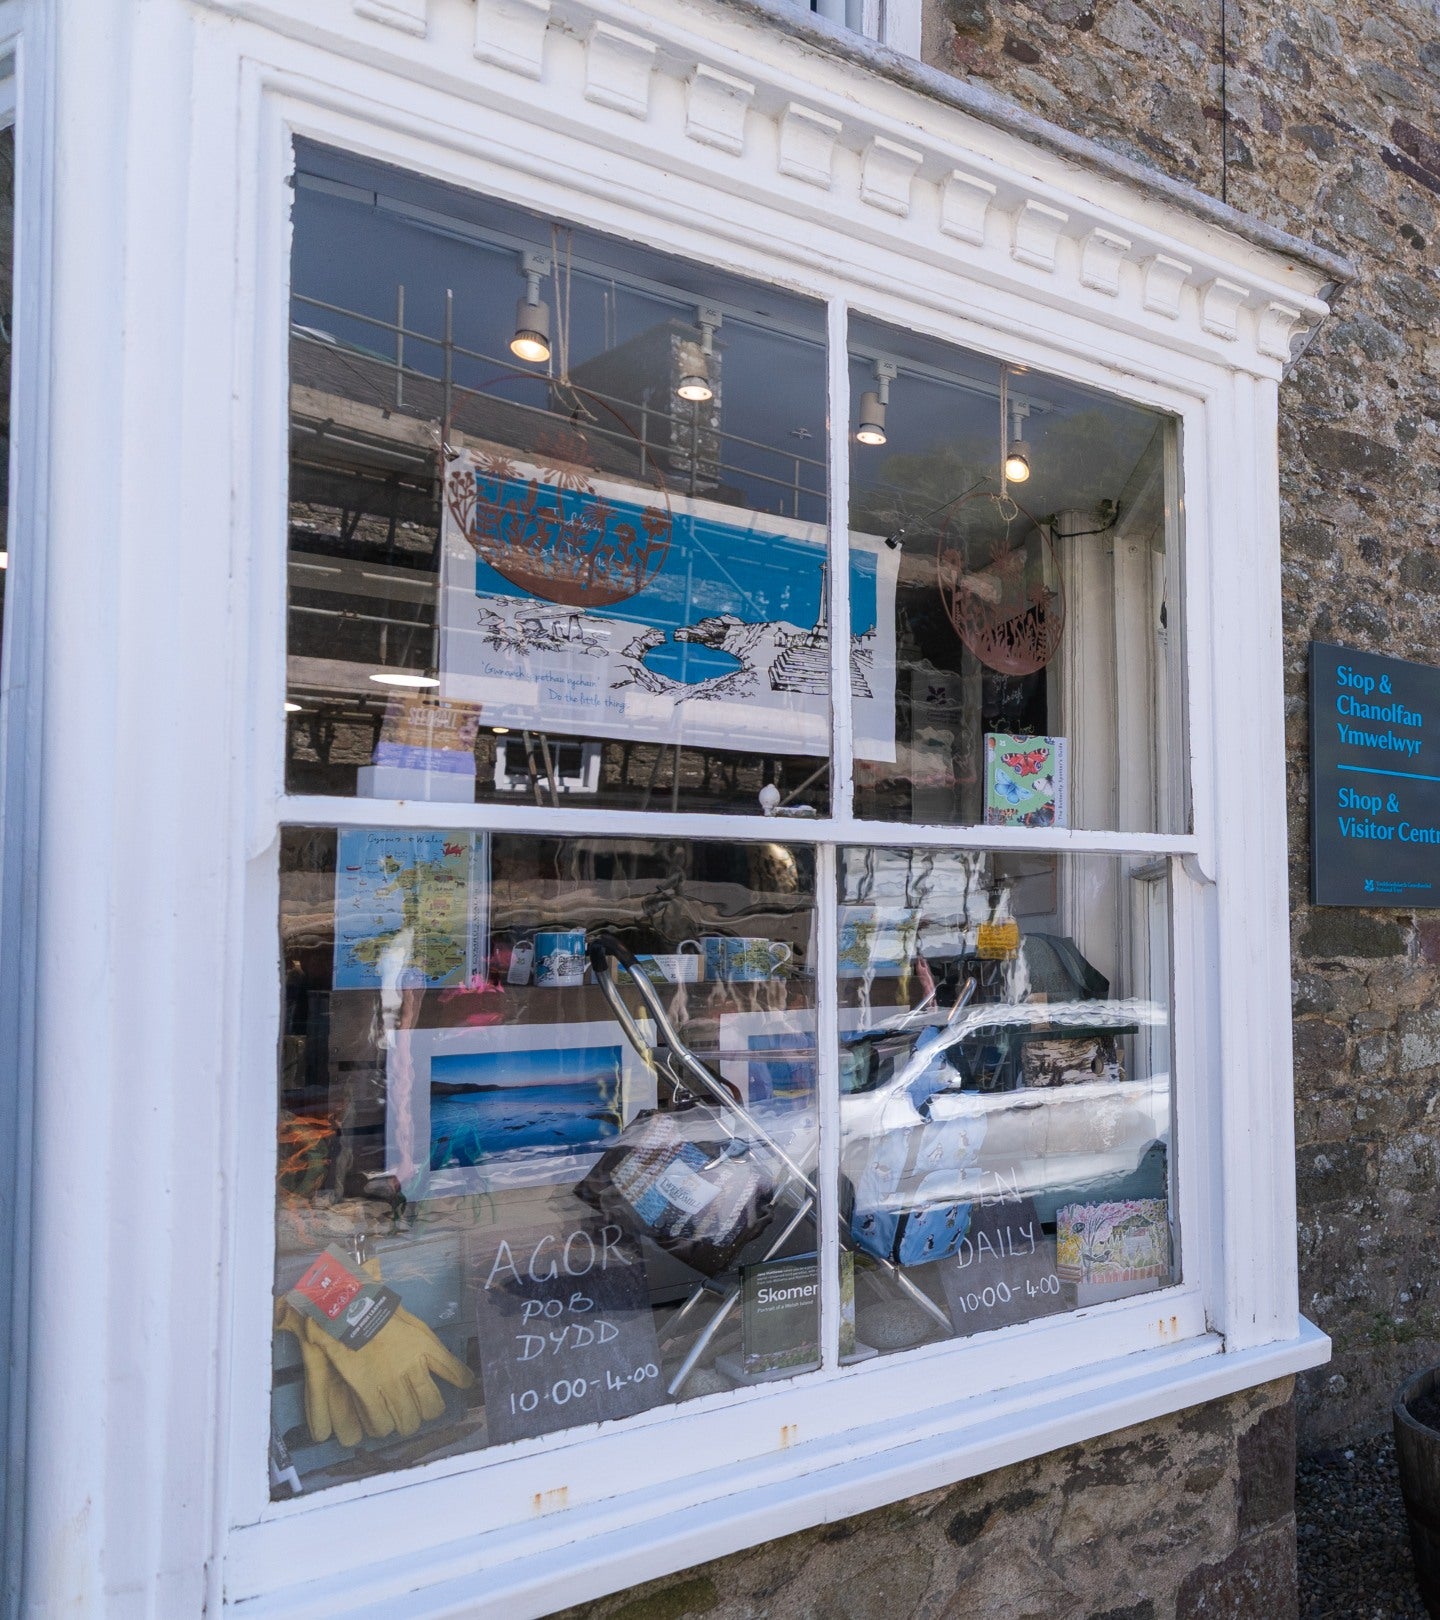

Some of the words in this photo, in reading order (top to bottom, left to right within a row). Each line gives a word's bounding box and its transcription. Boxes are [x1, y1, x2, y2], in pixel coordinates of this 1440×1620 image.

[1336, 664, 1374, 695] Siop
[1379, 674, 1392, 695] &
[548, 688, 562, 702] Do
[564, 694, 578, 704] the
[580, 693, 602, 708] little
[1336, 694, 1422, 728] Chanolfan
[1337, 722, 1422, 758] Ymwelwyr
[1338, 788, 1382, 816] Shop
[1386, 792, 1400, 813] &
[1338, 816, 1394, 840] Visitor
[484, 1224, 632, 1291] AGOR
[956, 1222, 1036, 1269] DAILY
[520, 1290, 595, 1326] POB
[757, 1284, 819, 1304] Skomer
[514, 1318, 621, 1362] DYDD
